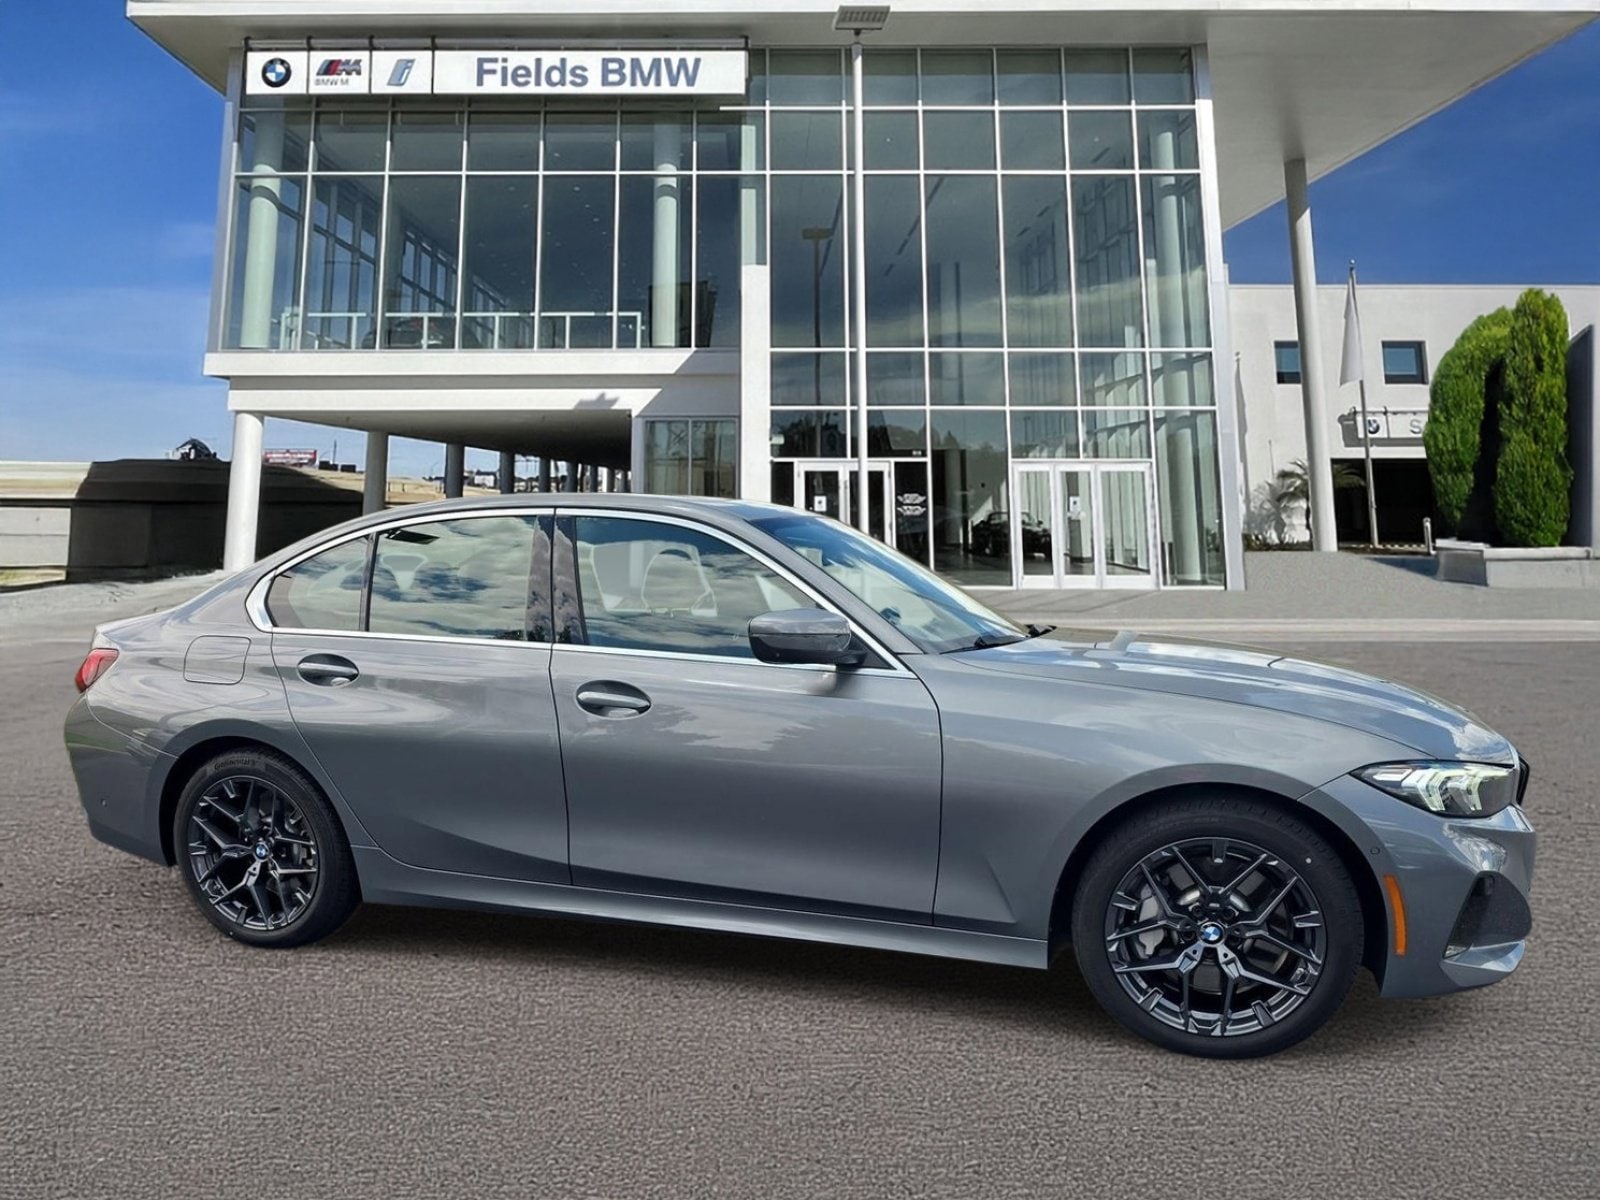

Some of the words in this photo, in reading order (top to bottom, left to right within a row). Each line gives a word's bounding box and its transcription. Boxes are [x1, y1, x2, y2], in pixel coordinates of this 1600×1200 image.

[476, 57, 589, 87] Fields
[601, 57, 702, 87] BMW
[314, 78, 339, 86] BMW
[340, 78, 350, 86] M
